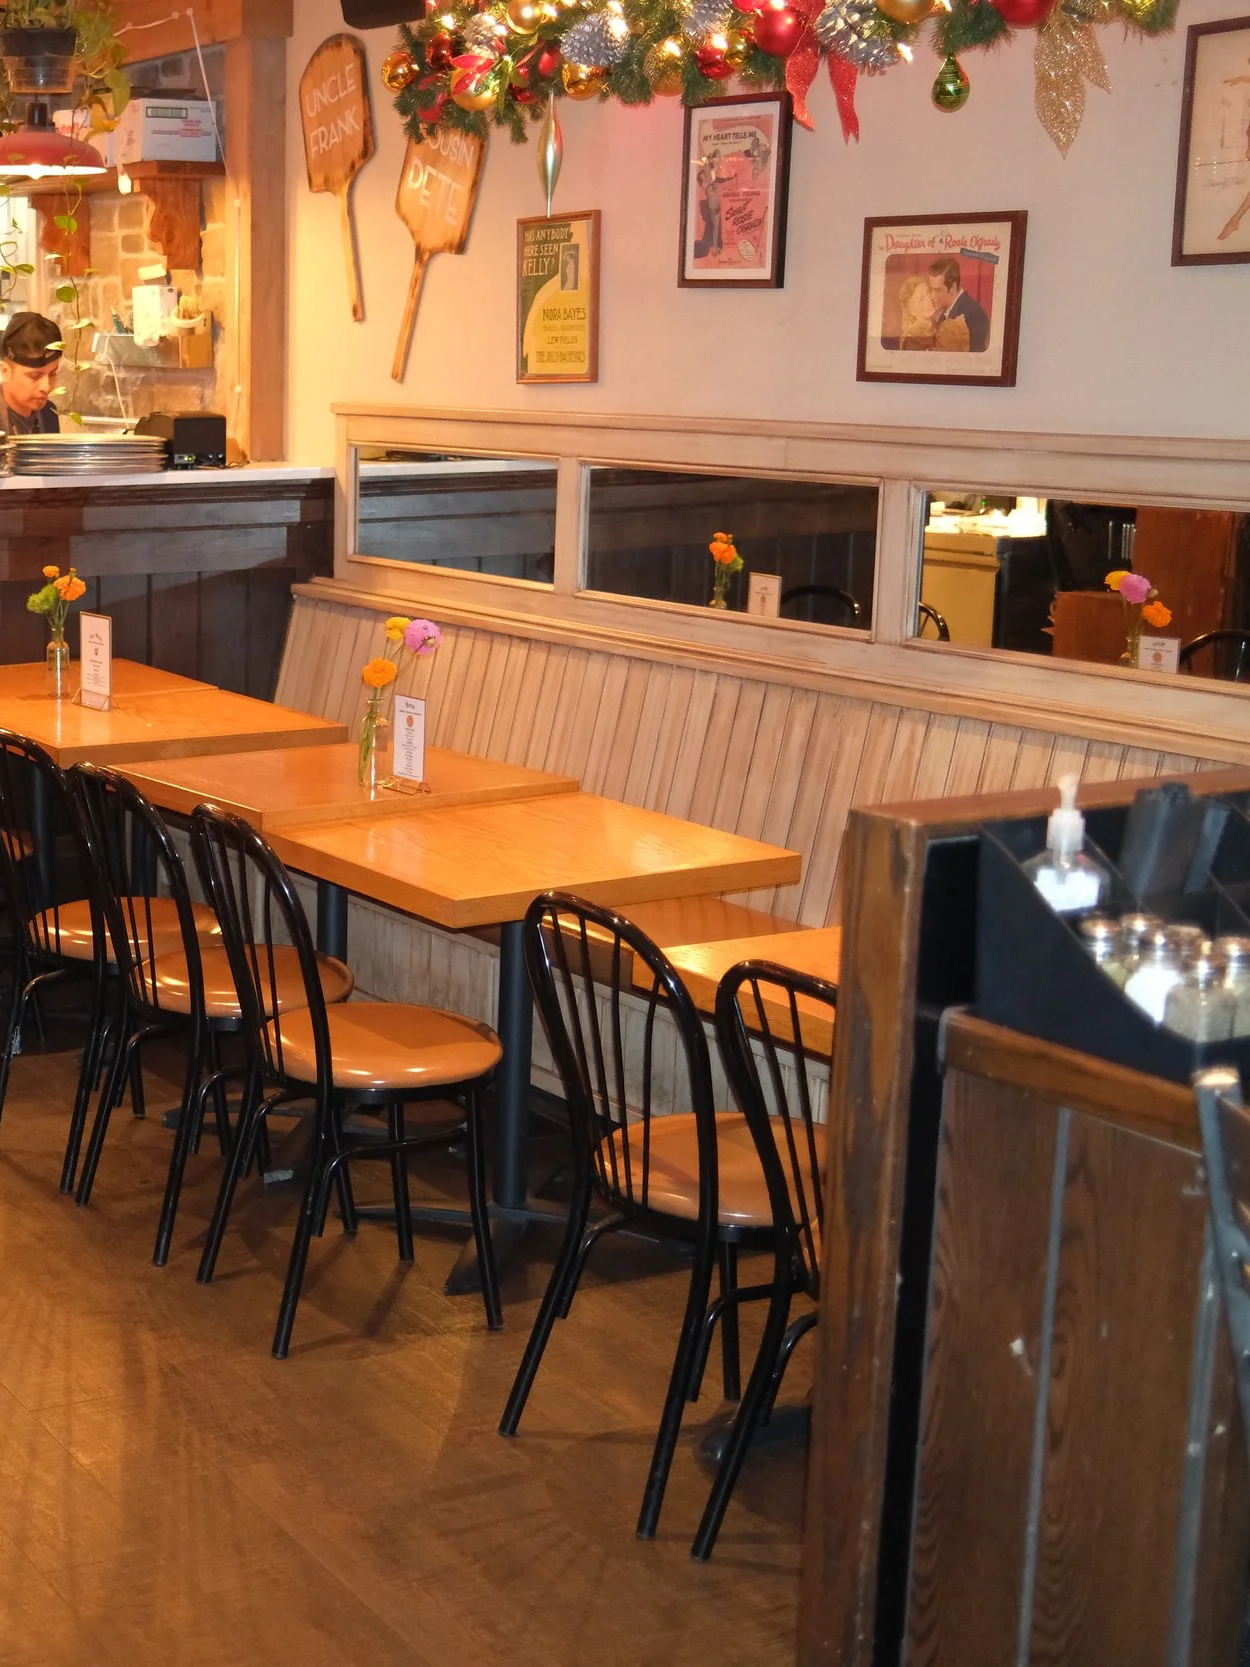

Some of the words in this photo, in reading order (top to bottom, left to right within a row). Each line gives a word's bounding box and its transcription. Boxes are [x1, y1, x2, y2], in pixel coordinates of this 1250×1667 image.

[305, 62, 356, 117] UNCLE
[310, 105, 360, 158] FRANK
[702, 134, 712, 142] MY
[713, 132, 731, 141] HEART
[732, 131, 747, 140] TELLS
[748, 130, 757, 138] ME
[536, 227, 570, 241] ANYBODY
[539, 243, 559, 256] SEEN
[884, 233, 926, 253] Daughter
[927, 235, 937, 249] of
[944, 234, 968, 250] Rosie
[522, 257, 555, 277] KELLY?
[542, 308, 561, 321] NORA
[562, 307, 586, 321] BAYES
